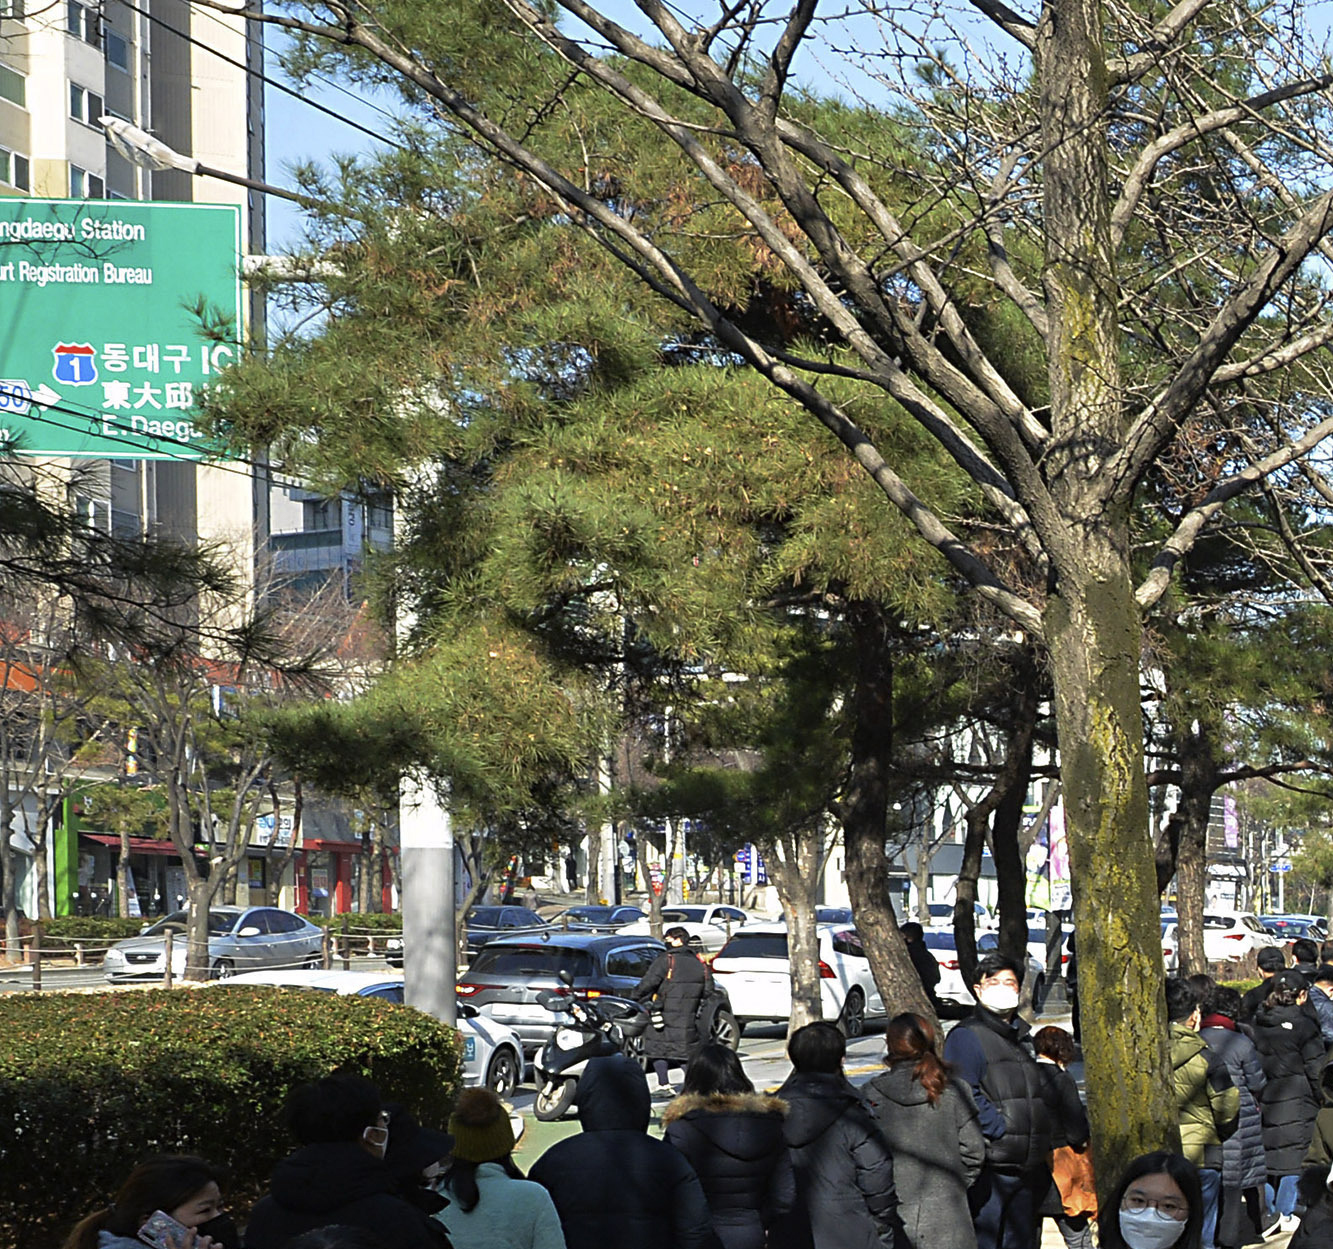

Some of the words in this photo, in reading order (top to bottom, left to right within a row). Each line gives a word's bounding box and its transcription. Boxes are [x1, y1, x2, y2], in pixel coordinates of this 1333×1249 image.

[81, 218, 145, 240] Station
[19, 261, 99, 287] Registration
[103, 262, 152, 284] Bureau
[70, 357, 80, 381] 1
[101, 343, 191, 374] 동대구
[201, 345, 233, 375] IC
[101, 380, 193, 410] 東大邱
